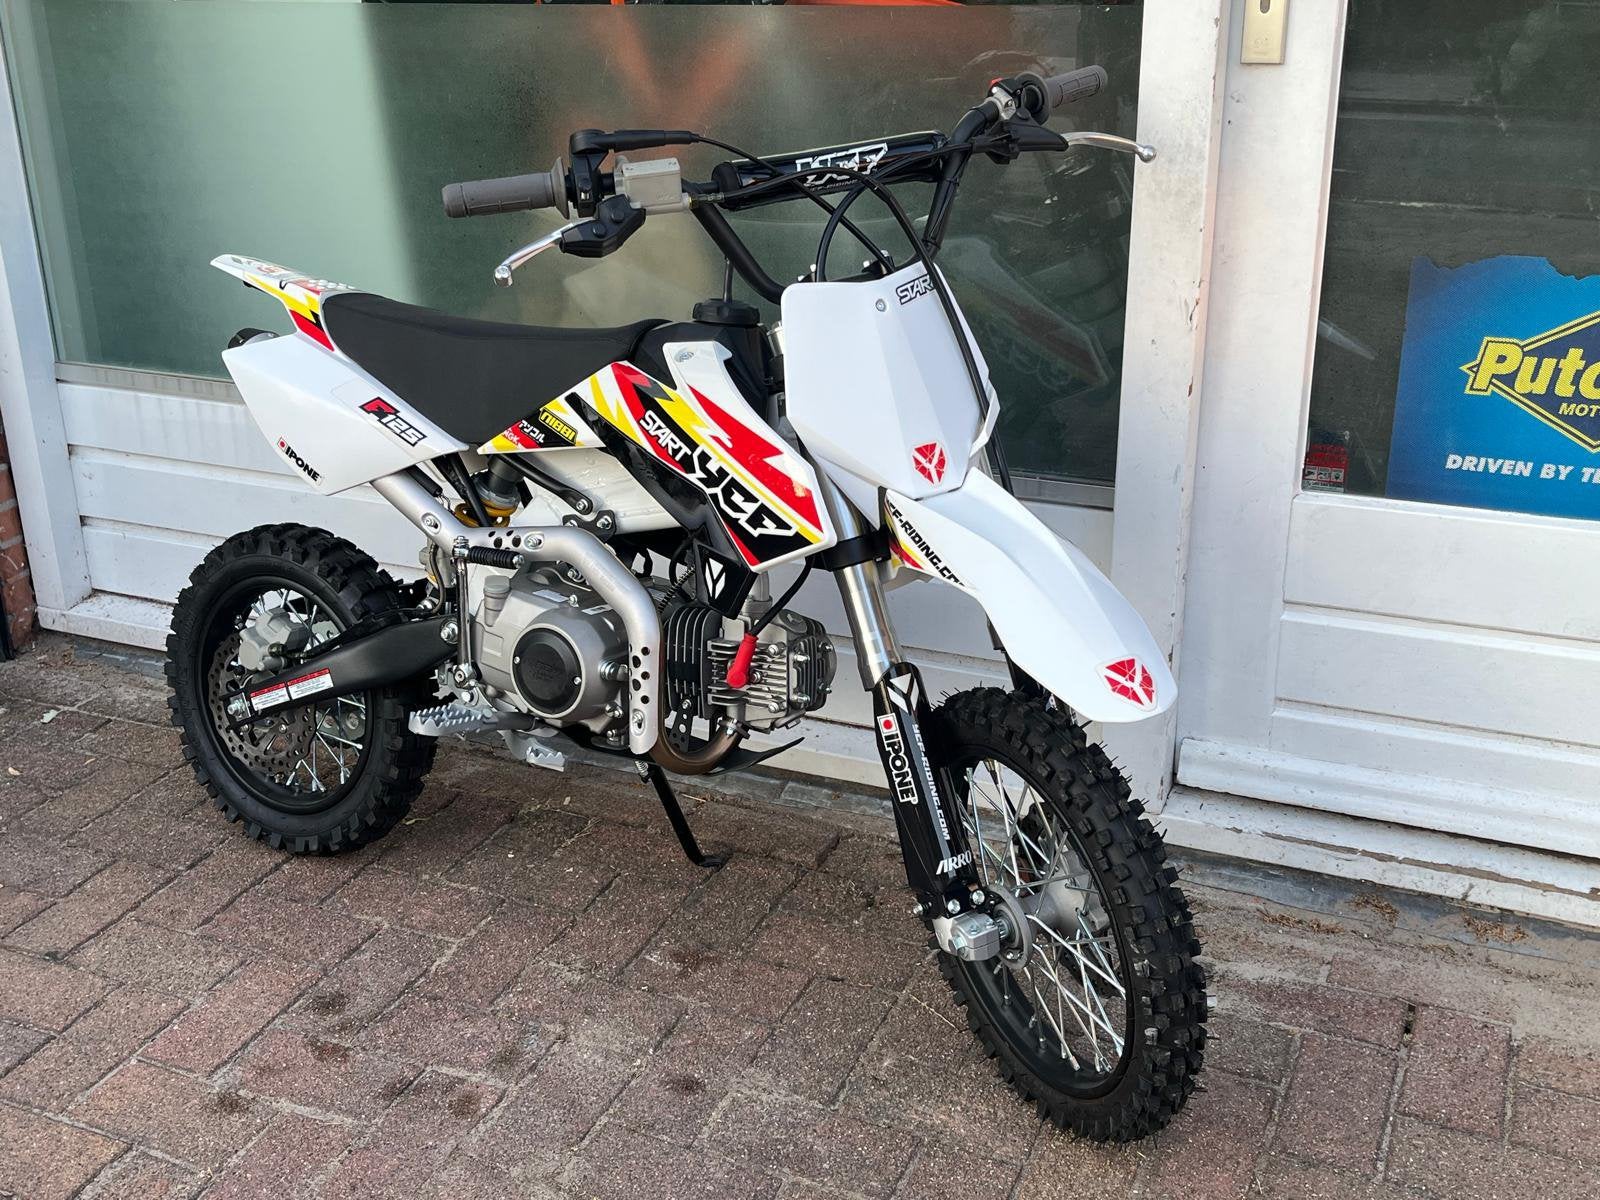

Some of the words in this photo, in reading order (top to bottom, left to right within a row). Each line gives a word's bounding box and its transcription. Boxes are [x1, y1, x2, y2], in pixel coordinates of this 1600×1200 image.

[896, 274, 934, 305] STAR
[639, 409, 693, 463] START
[285, 445, 322, 483] IPONE
[1445, 453, 1534, 477] DRIVEN
[1539, 463, 1574, 481] BY
[883, 731, 919, 805] IPONE
